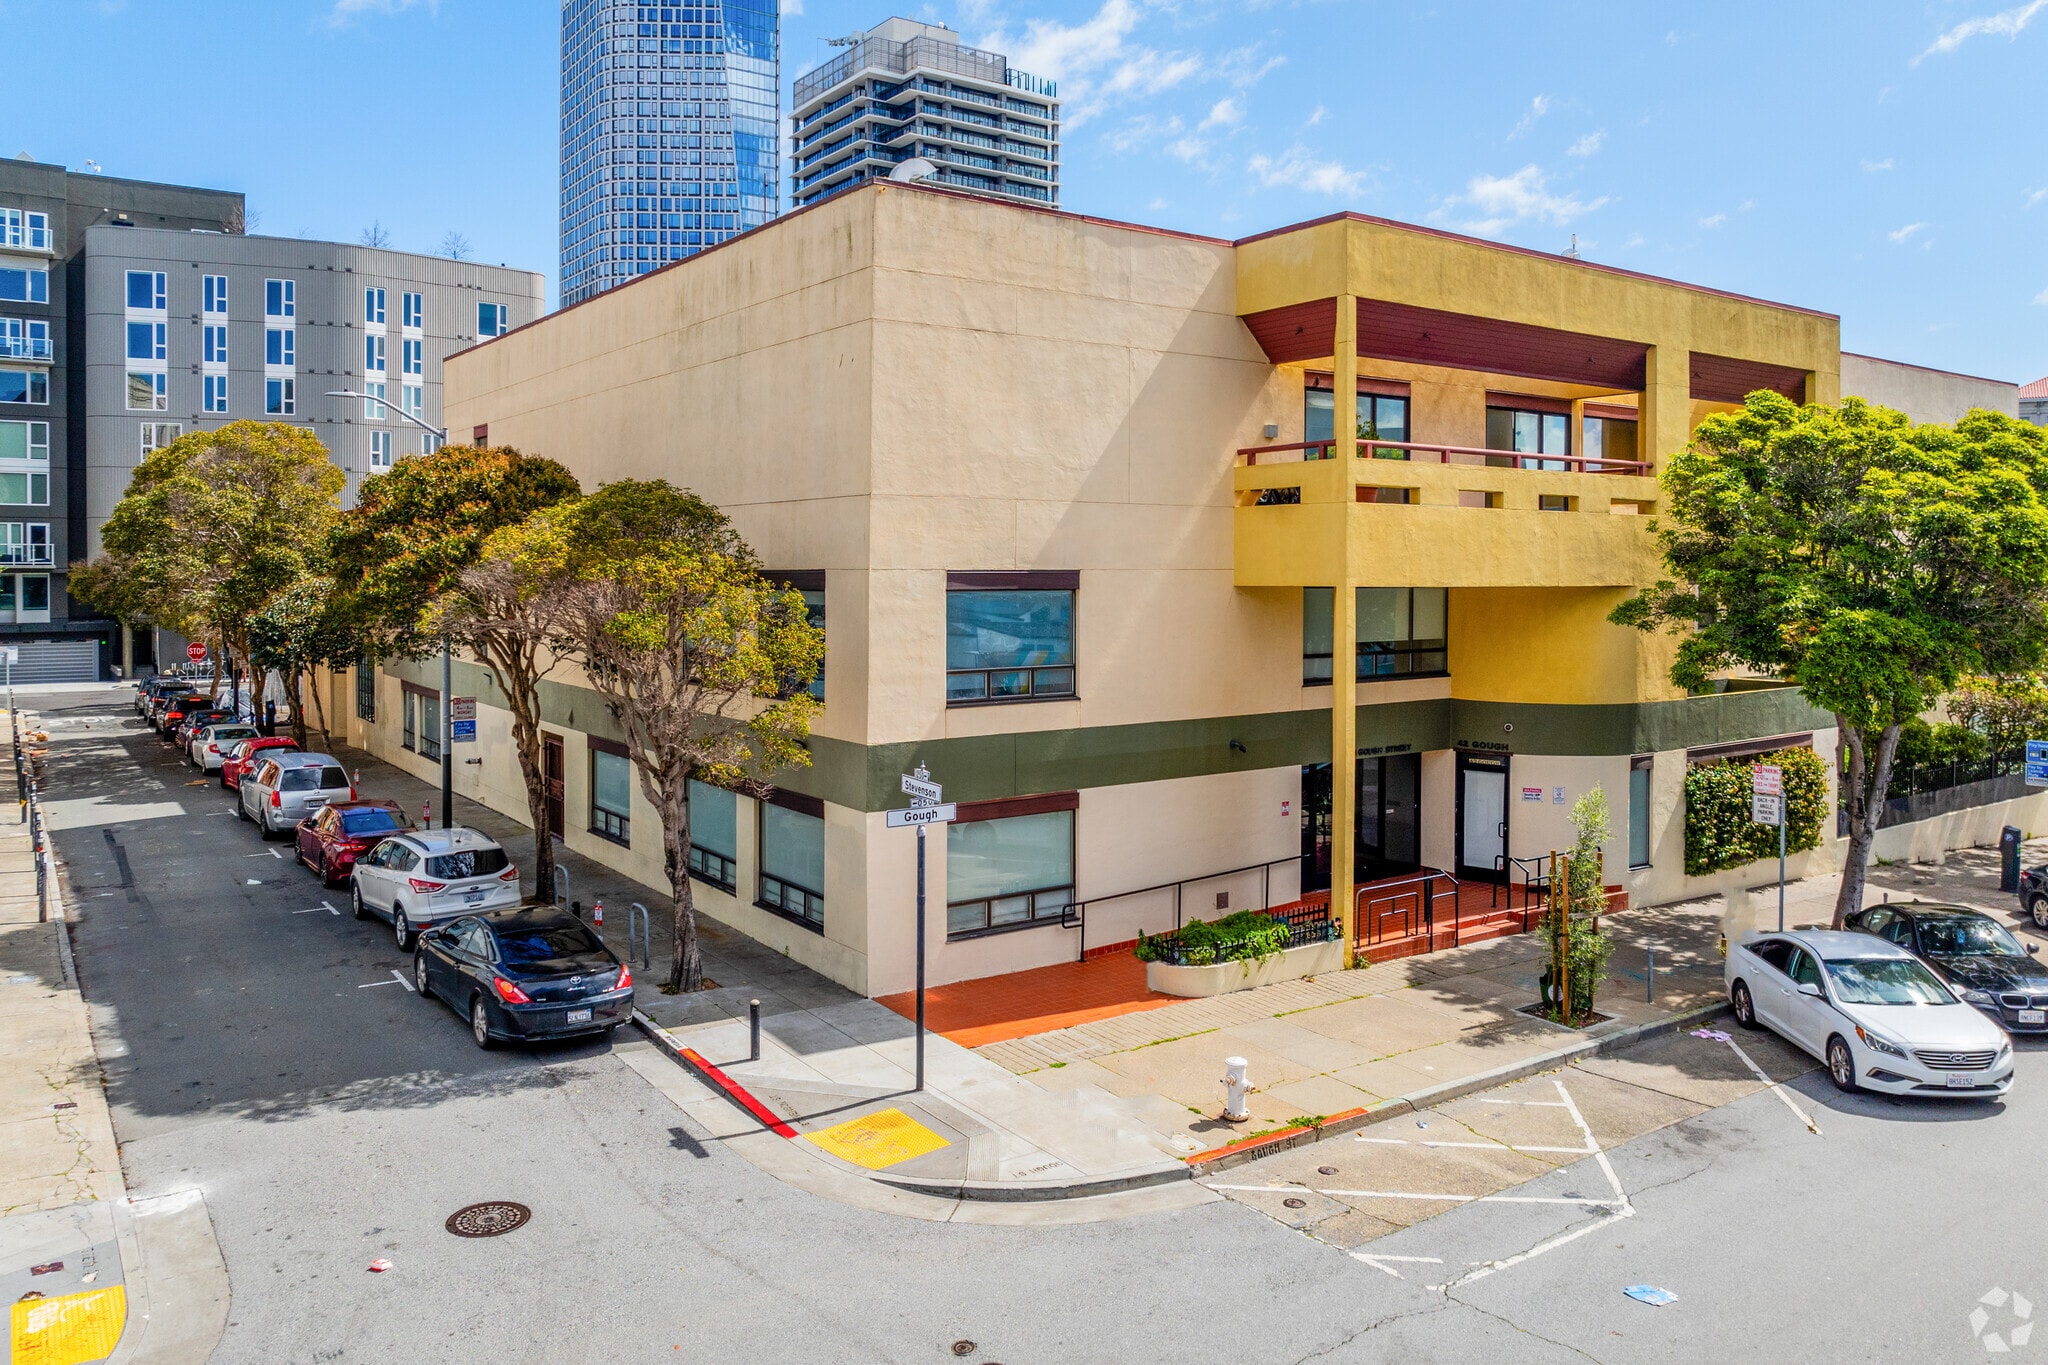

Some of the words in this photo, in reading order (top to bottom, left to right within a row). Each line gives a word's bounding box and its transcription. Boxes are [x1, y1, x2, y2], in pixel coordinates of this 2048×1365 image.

[188, 647, 206, 655] STOP
[1358, 747, 1382, 755] GOUGH
[1385, 744, 1411, 753] STREET
[1472, 741, 1509, 750] GOUGH
[1762, 767, 1780, 775] PARKING
[904, 780, 937, 799] Stevenson
[904, 809, 938, 823] Gough
